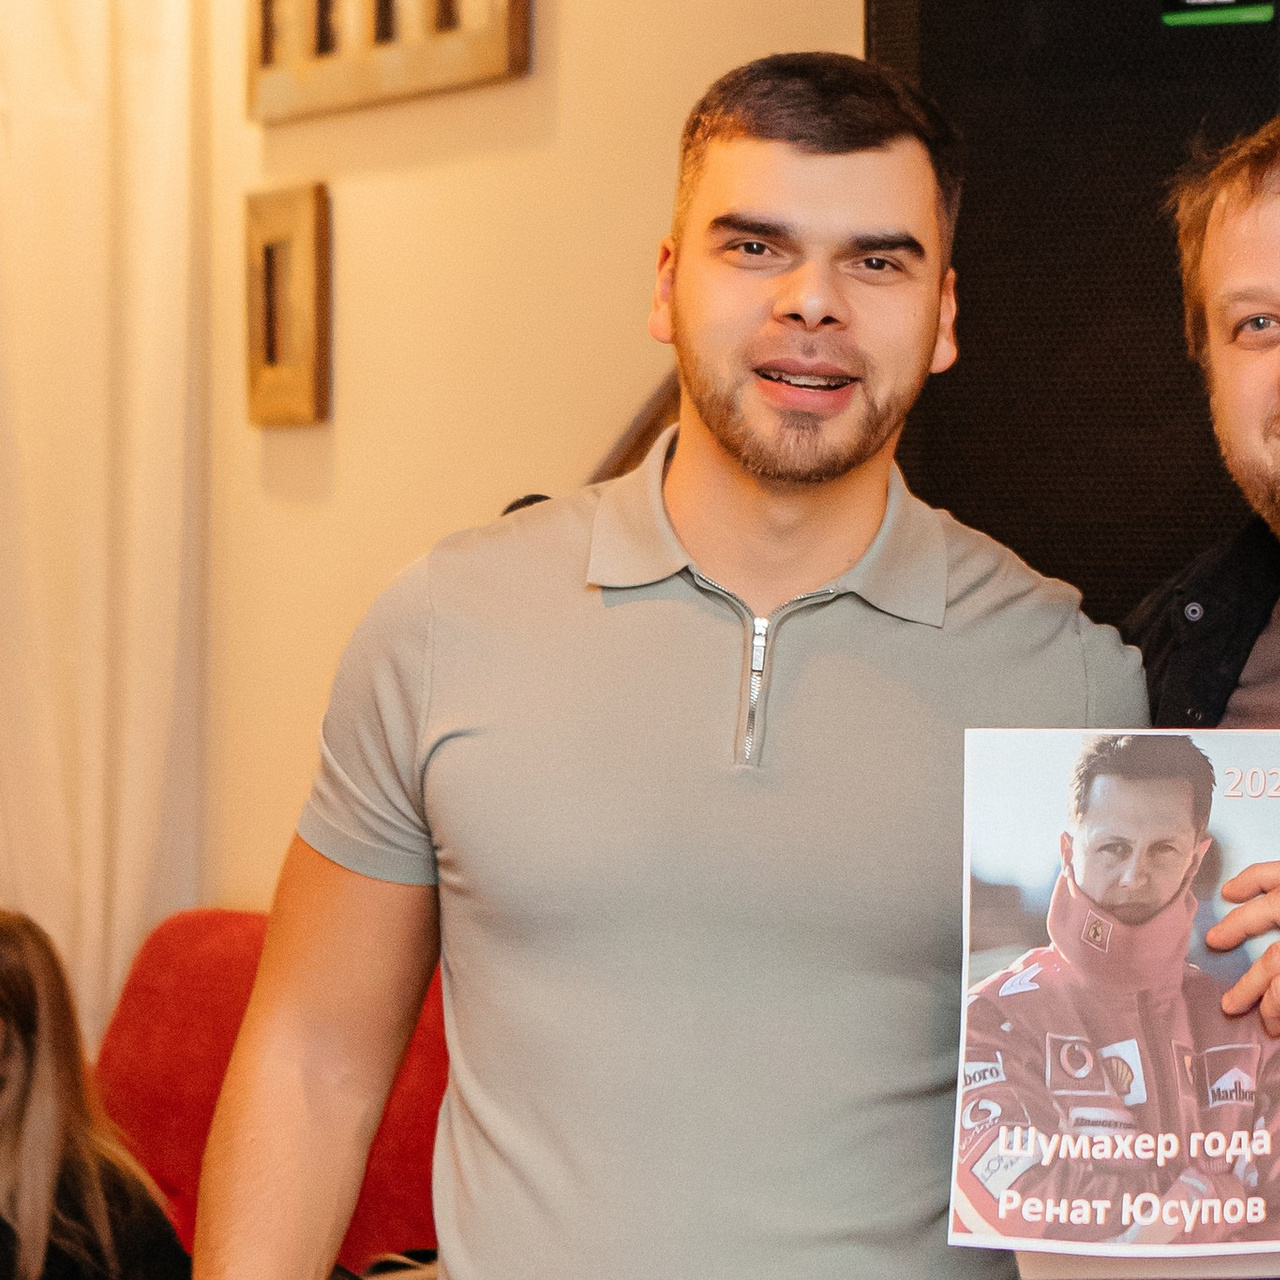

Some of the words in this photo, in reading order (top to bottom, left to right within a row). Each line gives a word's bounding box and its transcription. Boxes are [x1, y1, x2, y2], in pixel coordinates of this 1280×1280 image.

[998, 1125, 1179, 1167] Шумахер
[1190, 1129, 1271, 1163] года
[998, 1189, 1111, 1225] Ренат
[1122, 1192, 1266, 1233] Юсупов
